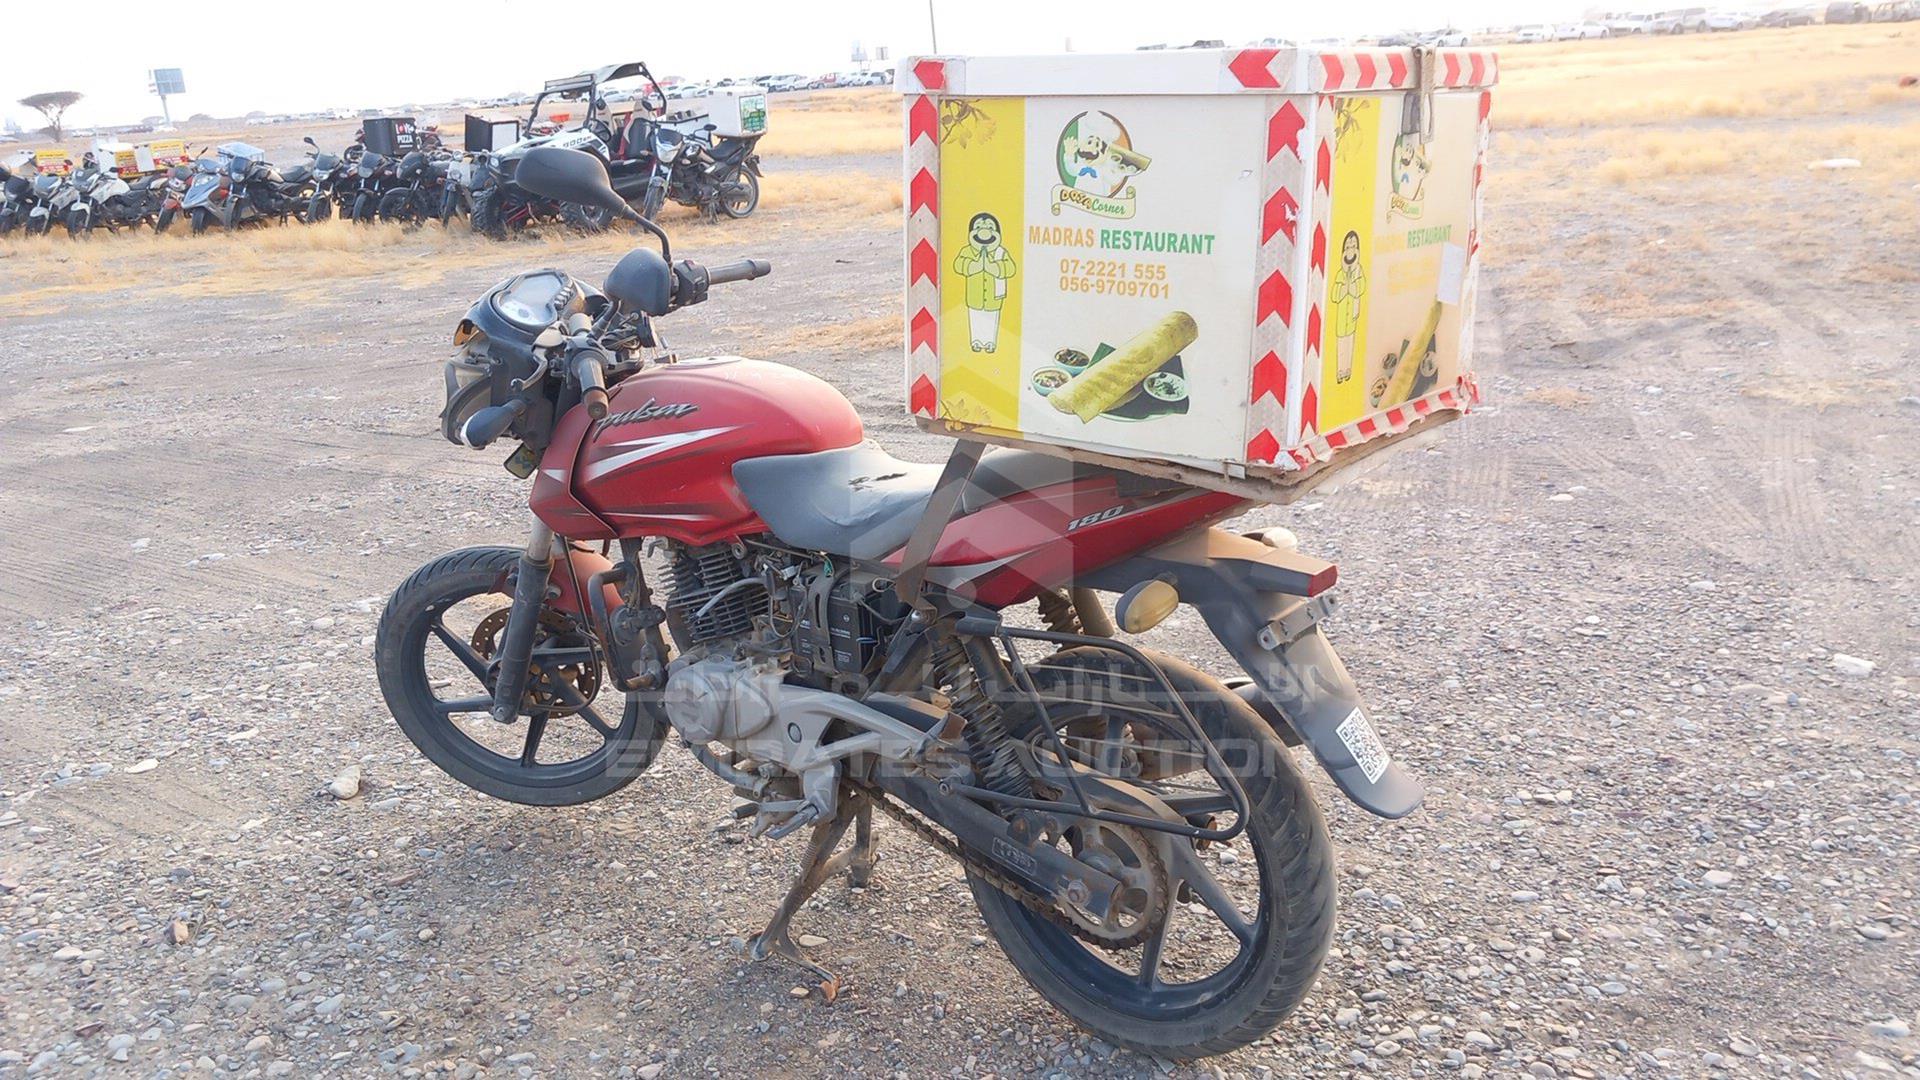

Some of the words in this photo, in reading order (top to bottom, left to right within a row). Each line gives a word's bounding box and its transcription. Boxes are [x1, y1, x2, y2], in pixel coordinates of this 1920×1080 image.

[397, 134, 414, 145] PIZZA
[1091, 199, 1126, 215] Corner
[1028, 225, 1095, 248] MADRAS
[1100, 229, 1216, 255] RESTAURANT
[1059, 258, 1127, 279] 07-2221
[1133, 263, 1167, 281] 555
[1059, 276, 1170, 299] 056-9709701
[1067, 505, 1124, 532] 180
